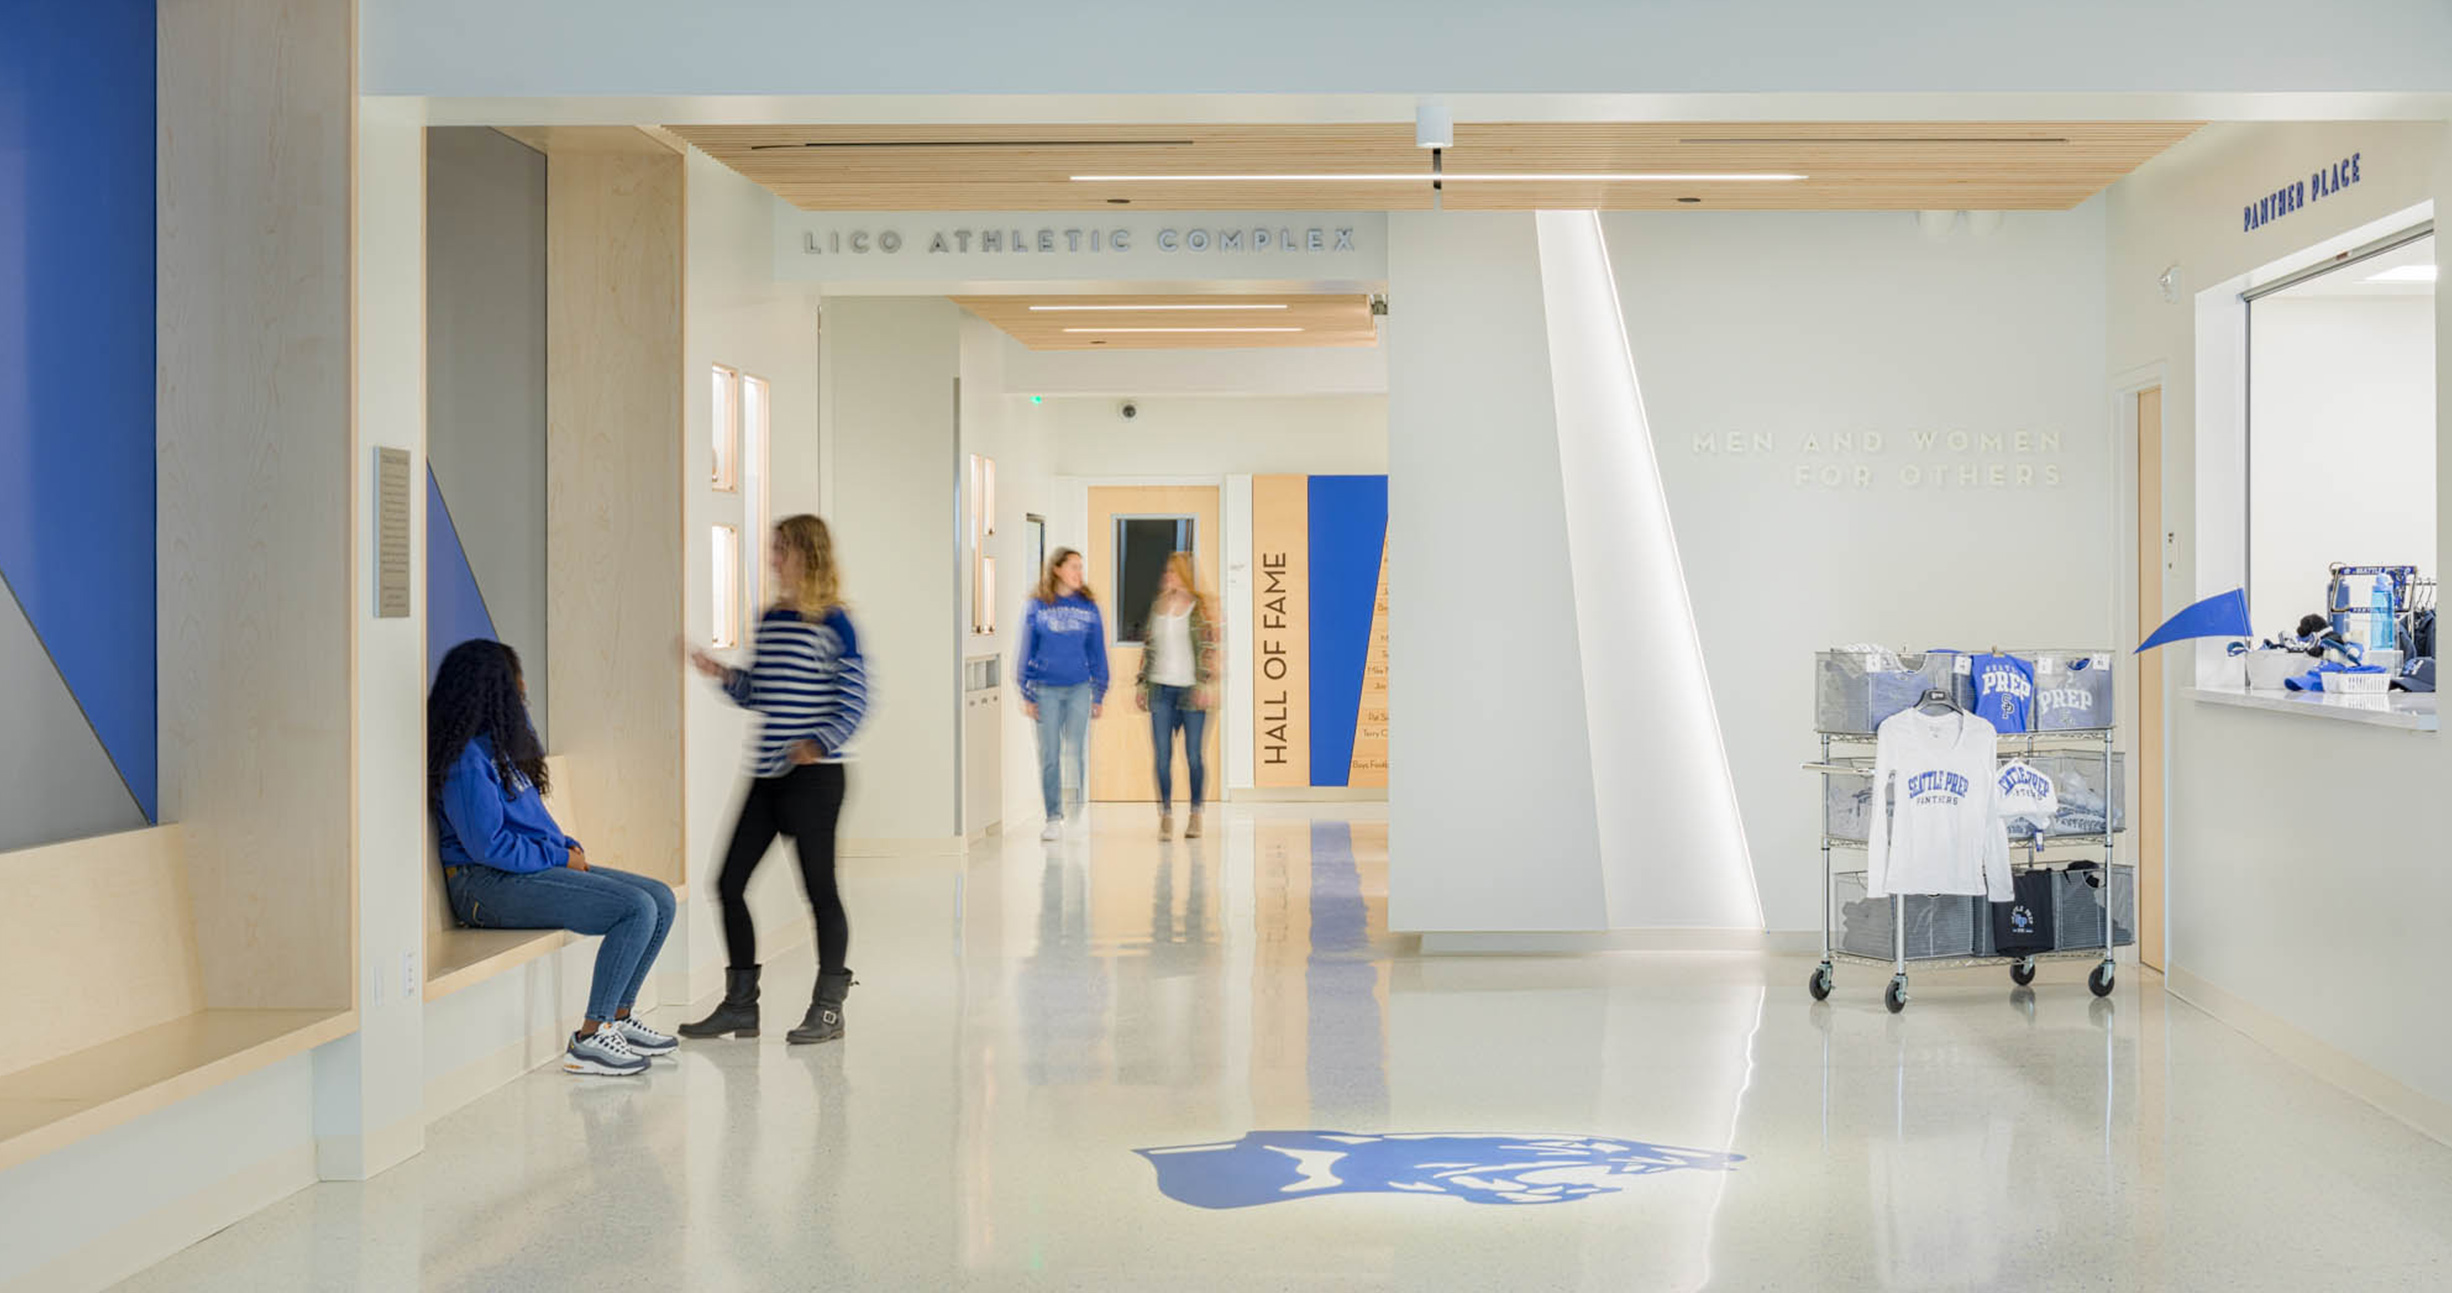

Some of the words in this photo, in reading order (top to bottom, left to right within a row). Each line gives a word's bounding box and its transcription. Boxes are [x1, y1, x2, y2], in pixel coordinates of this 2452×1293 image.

[2243, 181, 2304, 233] PANTHER
[2311, 152, 2361, 202] PLACE
[803, 230, 904, 256] LICO
[928, 229, 1132, 255] ATHLETIC
[1158, 227, 1356, 253] COMPLEX
[1692, 431, 1774, 454] MEN
[1803, 431, 1883, 454] AND
[1912, 430, 2062, 453] WOMEN
[1794, 464, 1872, 487] FOR
[1898, 463, 2063, 487] OTHERS
[1262, 552, 1286, 629] FAME
[1263, 640, 1287, 680] OF
[1981, 671, 2031, 700] PREP
[2037, 689, 2093, 714] PREP
[1264, 690, 1288, 764] HALL
[1908, 770, 1944, 799] SEATTLE
[1944, 772, 1970, 798] PREP
